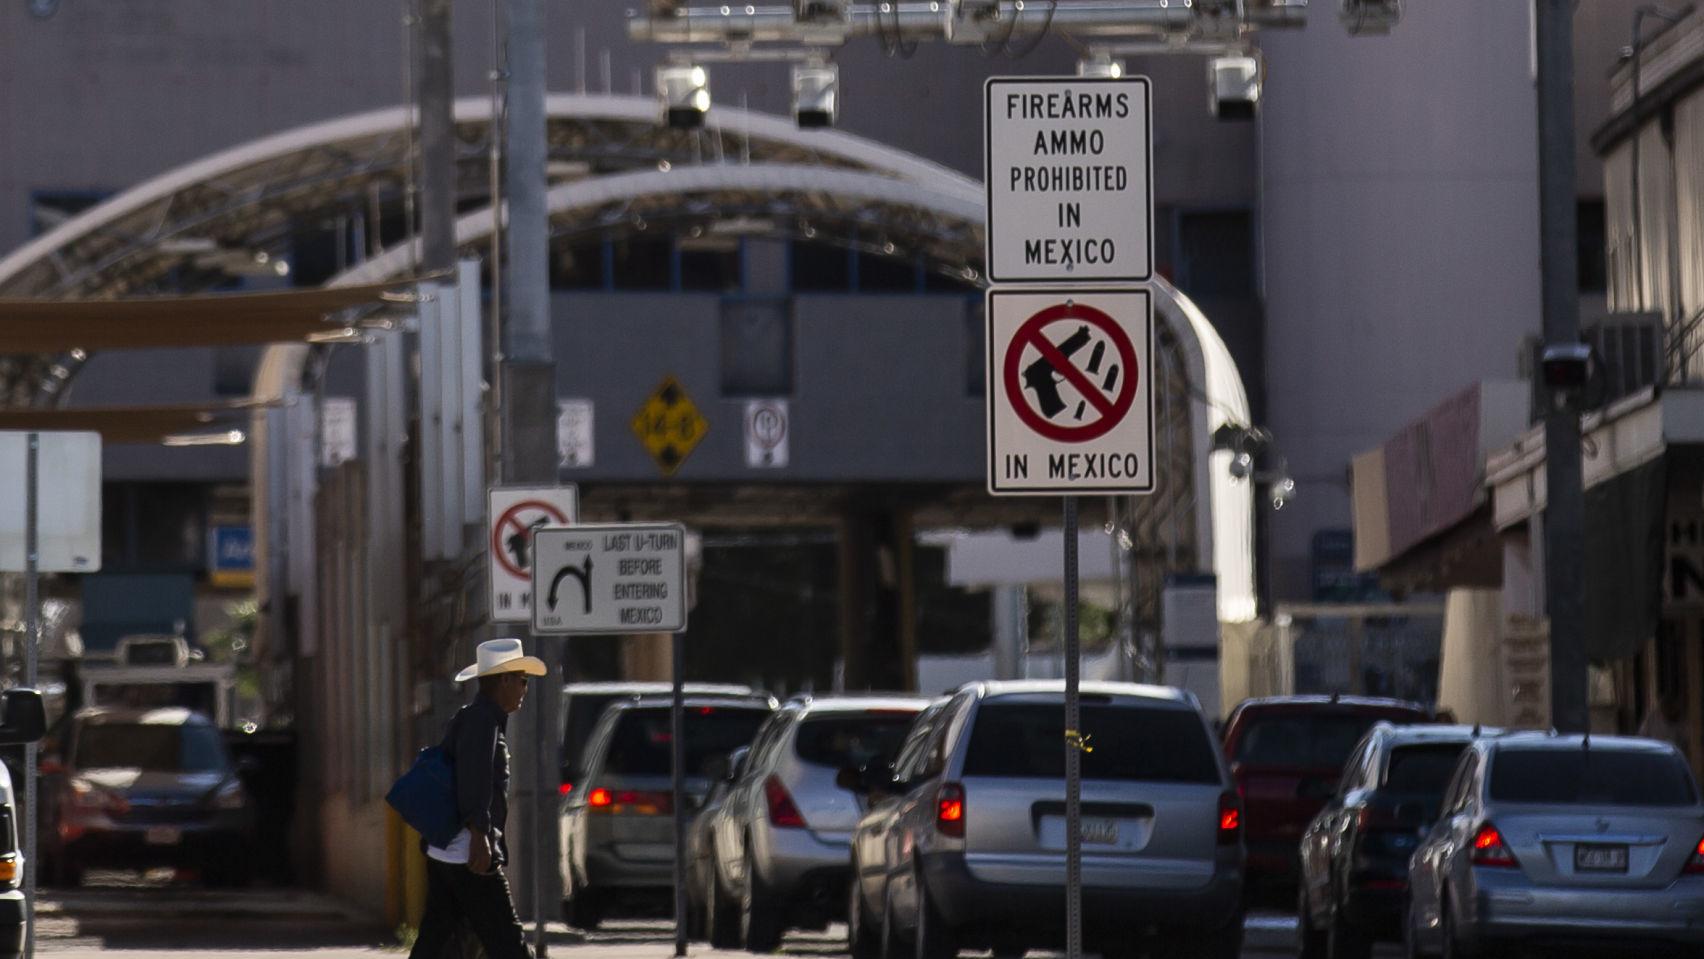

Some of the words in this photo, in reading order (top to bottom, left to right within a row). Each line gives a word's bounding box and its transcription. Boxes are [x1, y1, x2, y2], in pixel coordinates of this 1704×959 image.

[1007, 93, 1129, 119] FIREARMS
[1034, 130, 1104, 155] AMMO
[1010, 166, 1127, 192] PROHIBITED
[1058, 203, 1081, 228] IN
[1025, 239, 1115, 264] MEXICO
[1005, 454, 1028, 479] IN
[1048, 453, 1138, 479] MEXICO
[605, 535, 631, 551] LAST
[636, 534, 678, 550] U-TURN
[619, 559, 662, 575] BEFORE
[614, 583, 668, 600] ENTERING
[620, 607, 662, 624] MEXICO
